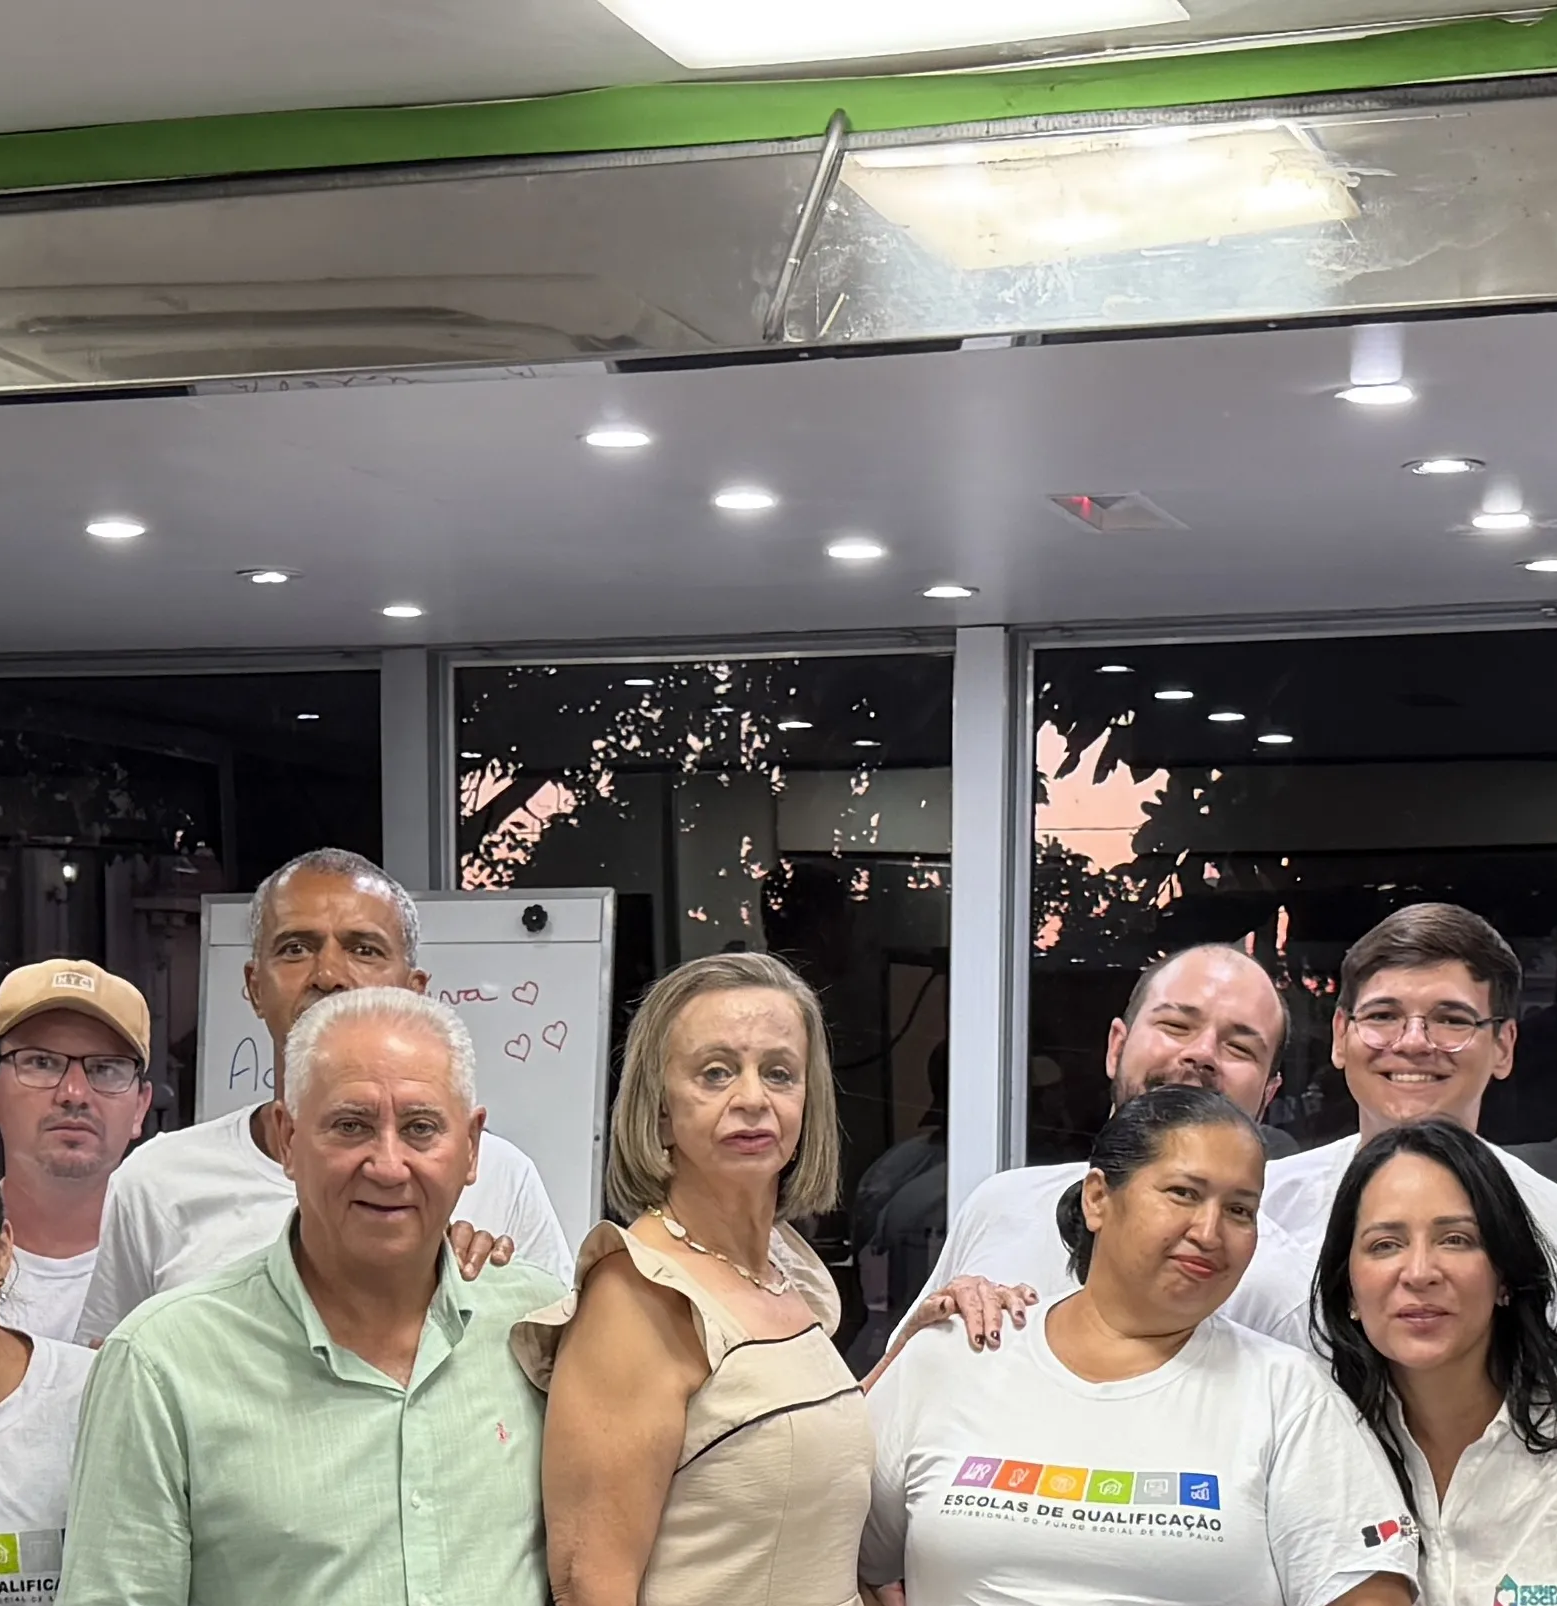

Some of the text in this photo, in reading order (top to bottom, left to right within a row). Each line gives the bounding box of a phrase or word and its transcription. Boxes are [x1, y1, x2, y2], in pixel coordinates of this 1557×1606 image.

[944, 1494, 1222, 1531] ESCOLAS DE QUALIFICAÇÃO
